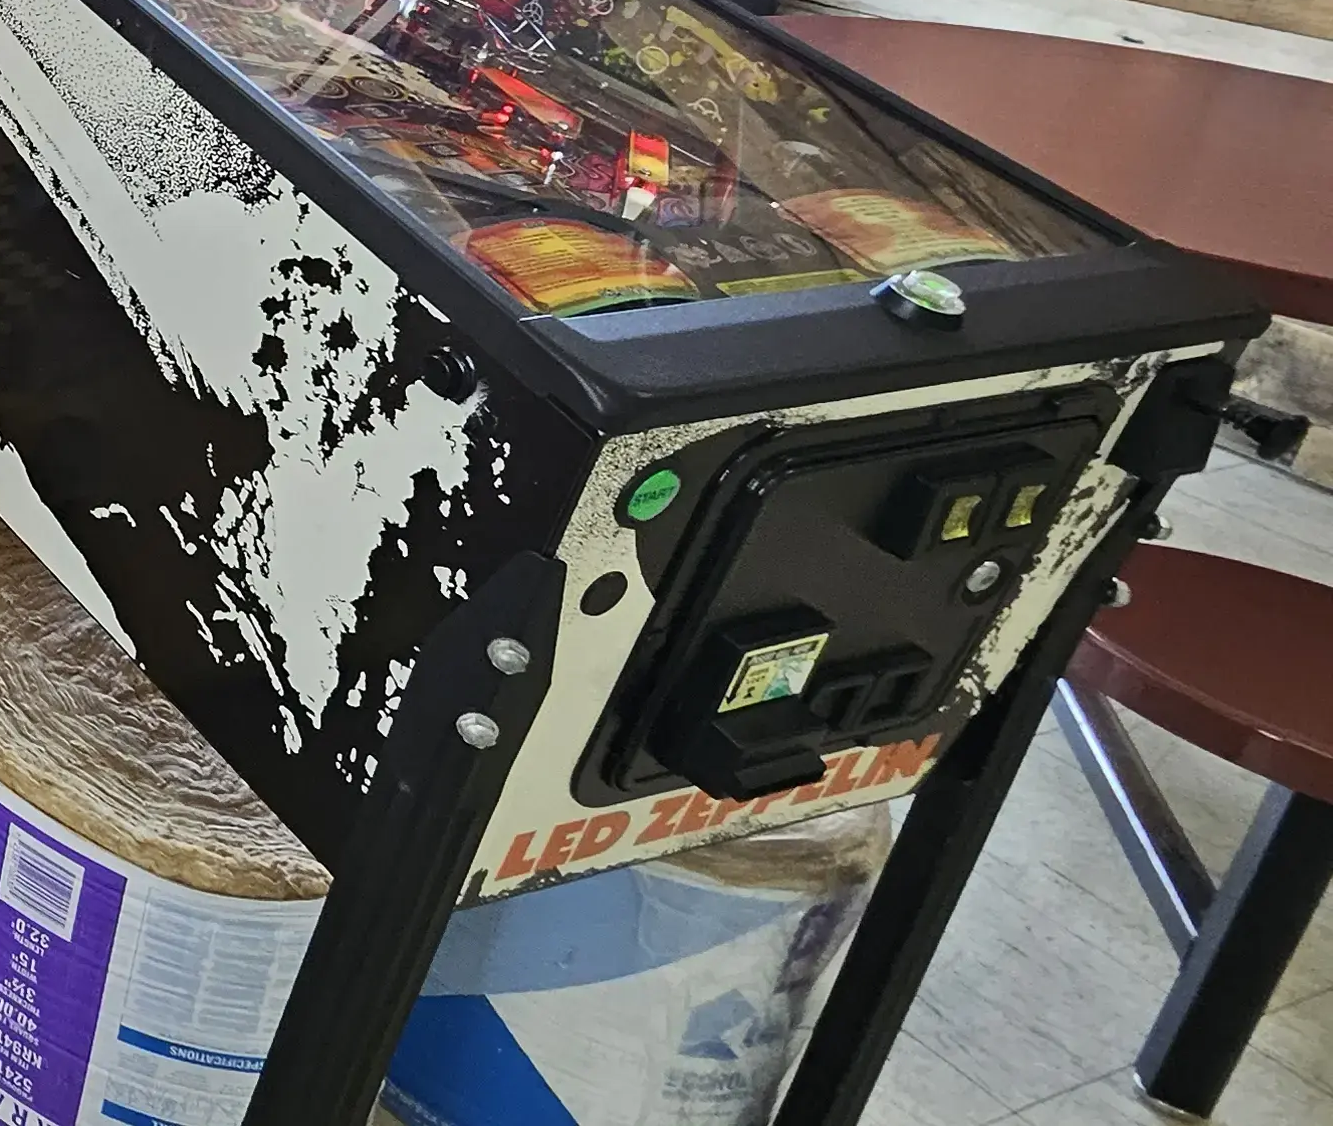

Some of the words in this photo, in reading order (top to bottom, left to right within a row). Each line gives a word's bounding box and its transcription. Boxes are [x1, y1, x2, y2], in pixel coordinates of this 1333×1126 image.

[494, 811, 631, 881] LED
[634, 733, 942, 846] ZEELIN
[11, 918, 50, 948] 32.0'
[12, 952, 37, 973] 15"
